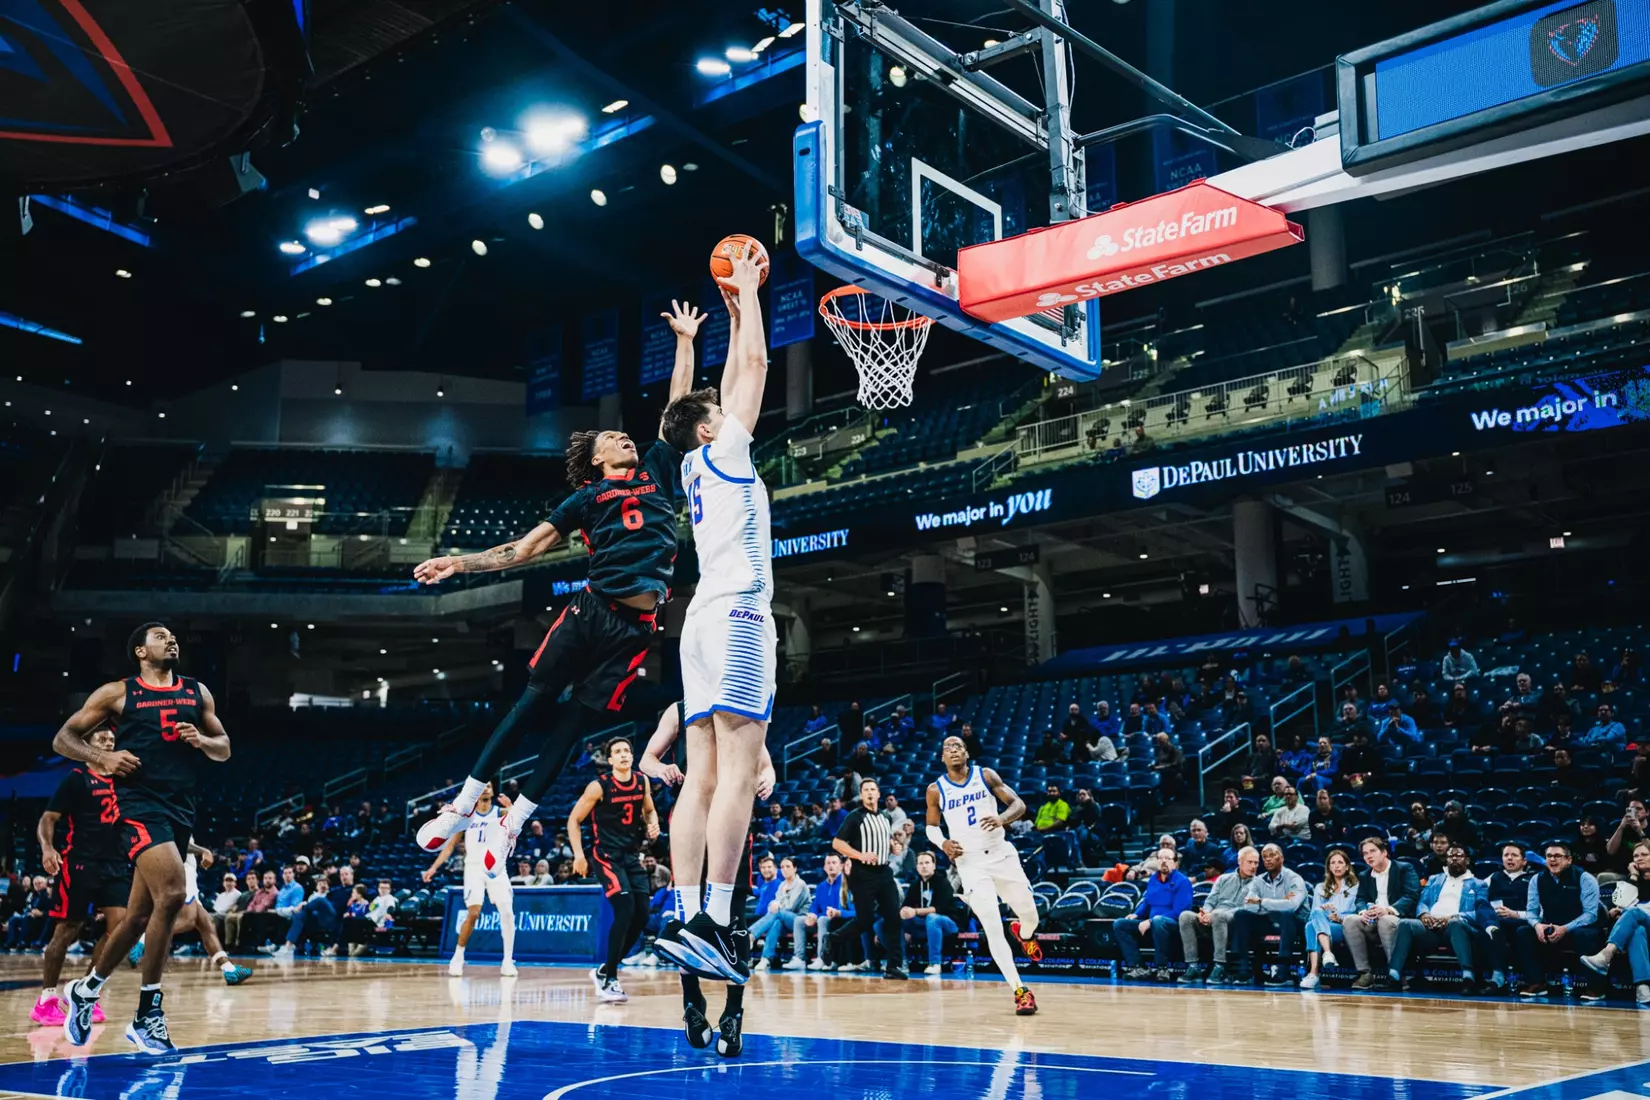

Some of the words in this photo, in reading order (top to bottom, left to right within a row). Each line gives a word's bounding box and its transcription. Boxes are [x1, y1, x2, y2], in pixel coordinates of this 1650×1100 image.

[1171, 162, 1202, 181] NCAA
[1058, 386, 1074, 399] 224
[1471, 409, 1512, 431] We
[1516, 396, 1588, 422] major
[1593, 390, 1618, 409] in
[1238, 434, 1363, 475] UNIVERSITY
[596, 484, 657, 504] GARDNER-WEBB
[1388, 492, 1411, 505] 124
[1450, 482, 1474, 496] 125
[621, 496, 645, 531] 6
[915, 513, 941, 530] We
[943, 505, 986, 527] major
[989, 501, 1004, 518] in
[1001, 488, 1052, 527] you
[769, 528, 850, 559] UNIVERSITY
[976, 558, 993, 569] 123
[1019, 553, 1036, 563] 124
[136, 698, 197, 709] GARDNER-WEBB
[160, 708, 180, 742] 5
[621, 803, 634, 825] 3
[967, 806, 977, 826] 2
[519, 911, 592, 932] UNIVERSITY
